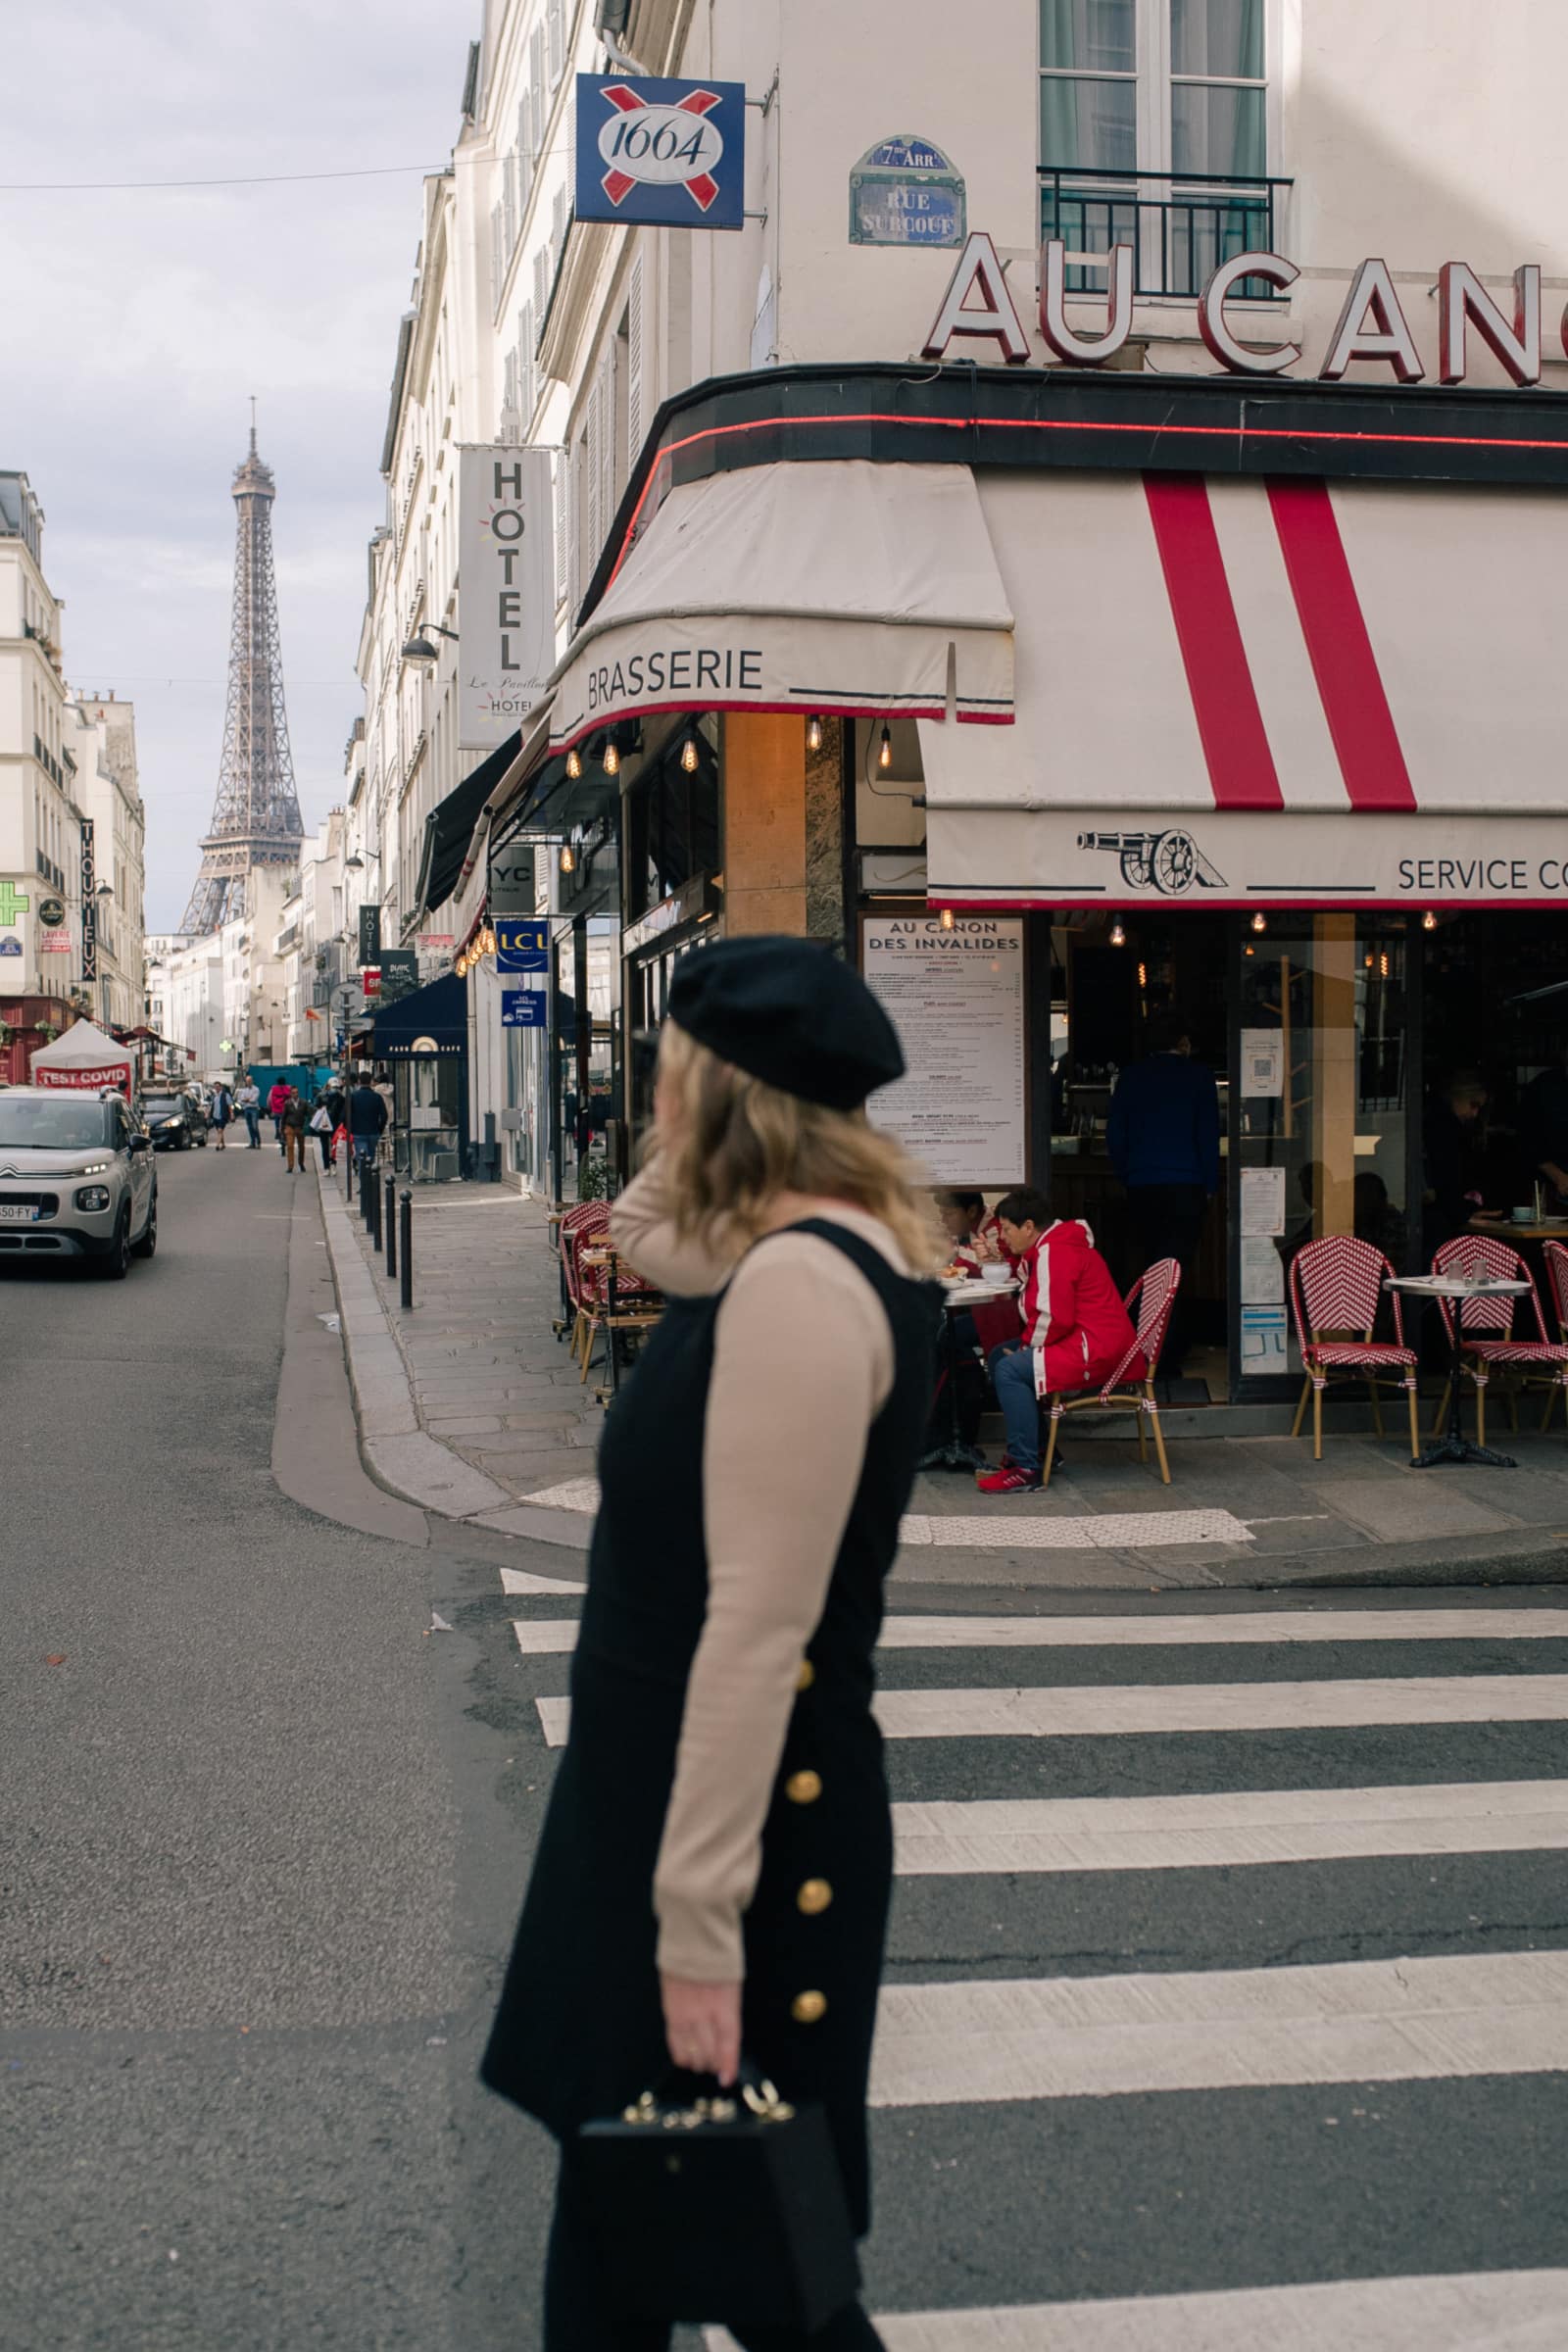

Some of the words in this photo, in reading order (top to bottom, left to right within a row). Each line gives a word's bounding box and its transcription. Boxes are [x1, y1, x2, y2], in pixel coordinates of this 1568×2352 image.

[612, 116, 710, 166] 1664
[887, 192, 930, 211] RUE
[862, 215, 955, 234] SURCOUF
[922, 232, 1134, 368] AU
[1198, 250, 1568, 388] CAN
[491, 462, 525, 671] HOTEL
[588, 650, 763, 710] BRASSERIE
[1398, 858, 1528, 890] SERVICE
[1539, 858, 1568, 890] C
[82, 821, 96, 978] THOUMIEUX
[890, 922, 917, 934] AU
[501, 933, 549, 950] LCL
[869, 938, 906, 950] DES
[915, 938, 1020, 950] INVALIDES
[42, 1072, 78, 1085] TEST
[79, 1068, 126, 1083] COVID
